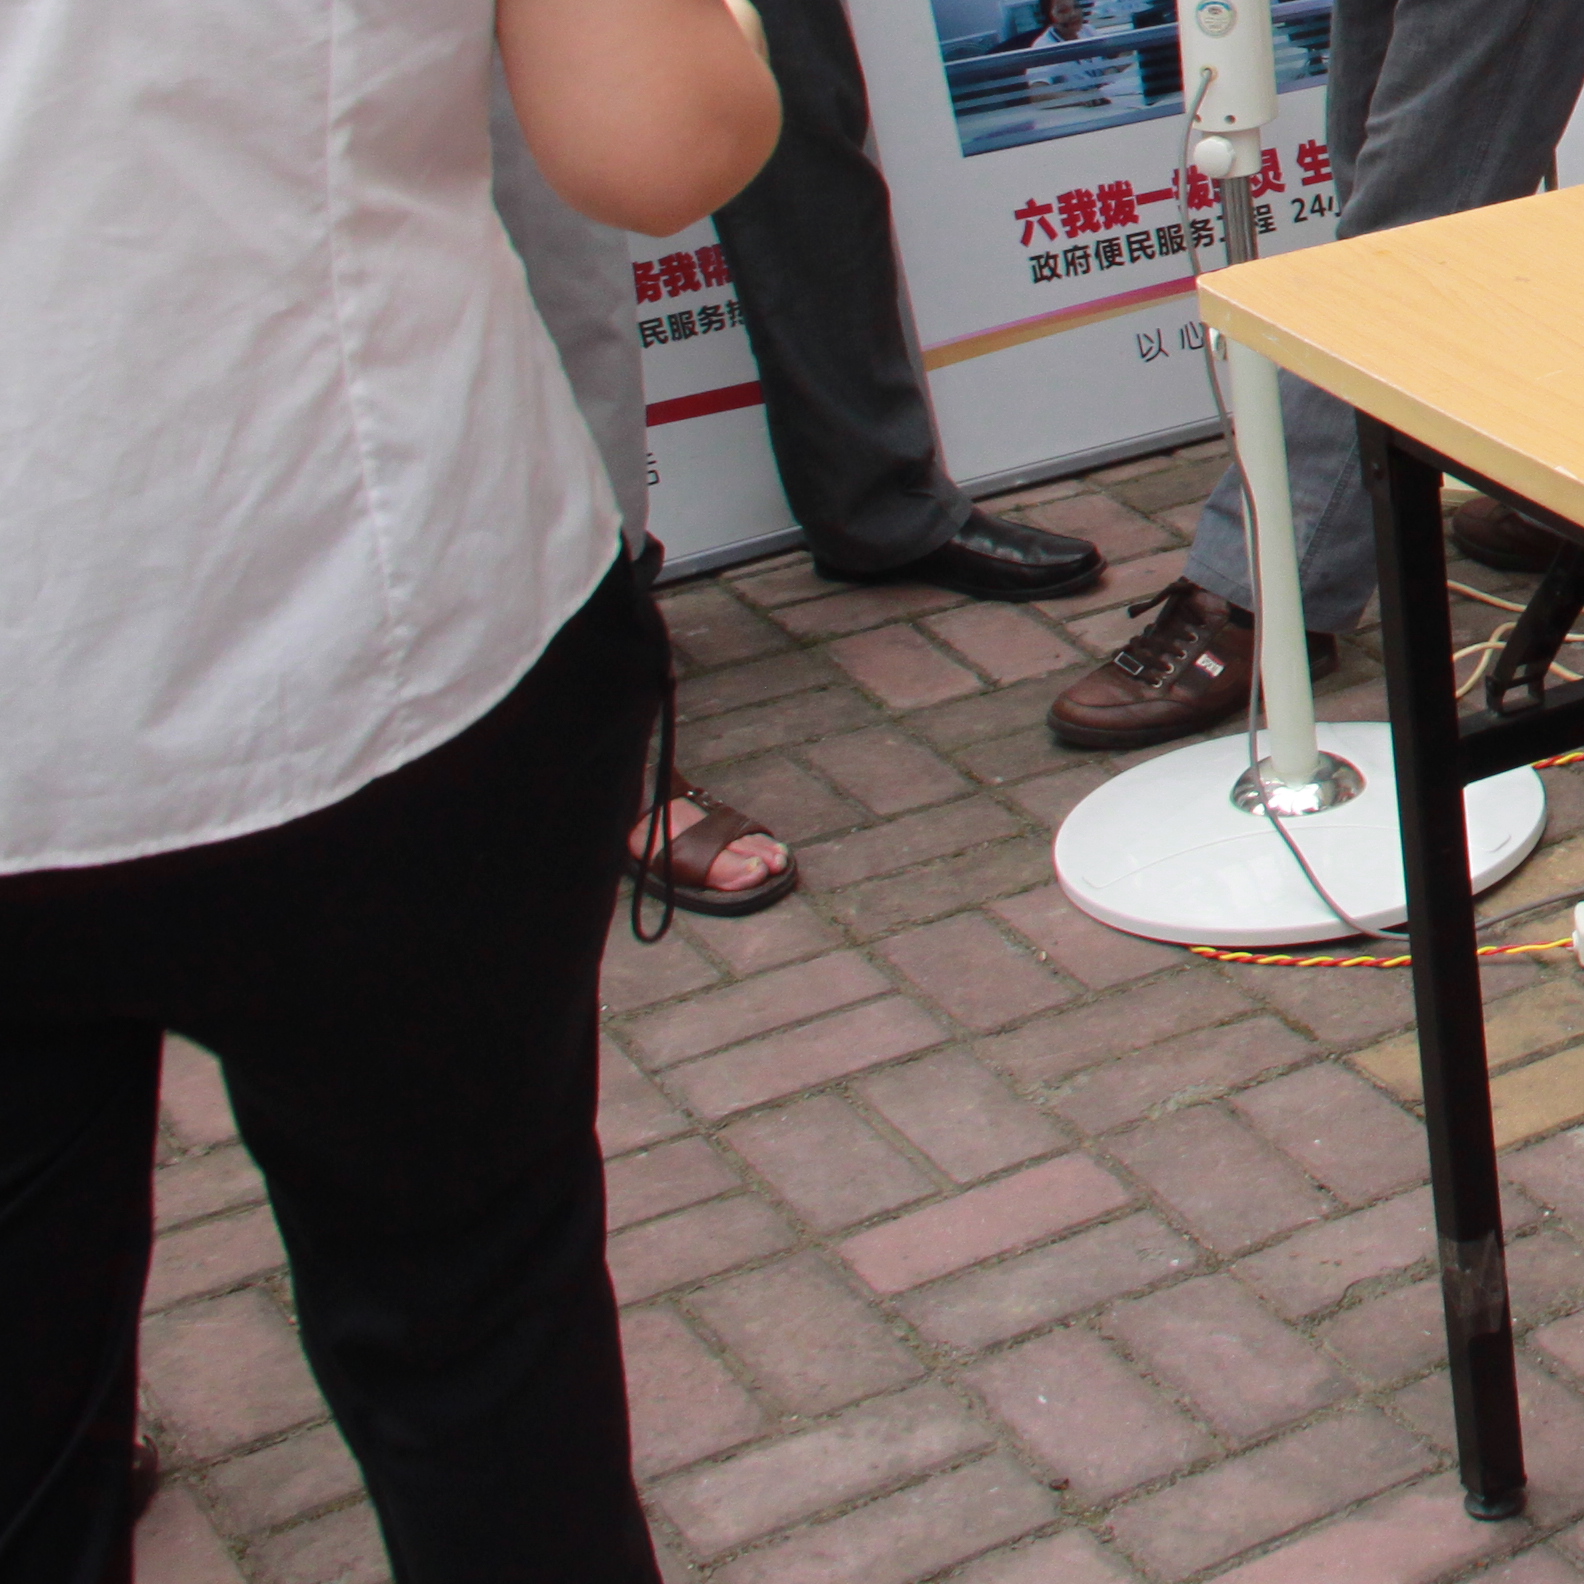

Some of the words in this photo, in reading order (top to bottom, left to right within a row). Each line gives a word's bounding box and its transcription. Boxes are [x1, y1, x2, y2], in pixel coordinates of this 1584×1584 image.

[1030, 203, 1277, 285] 政府便民服务程
